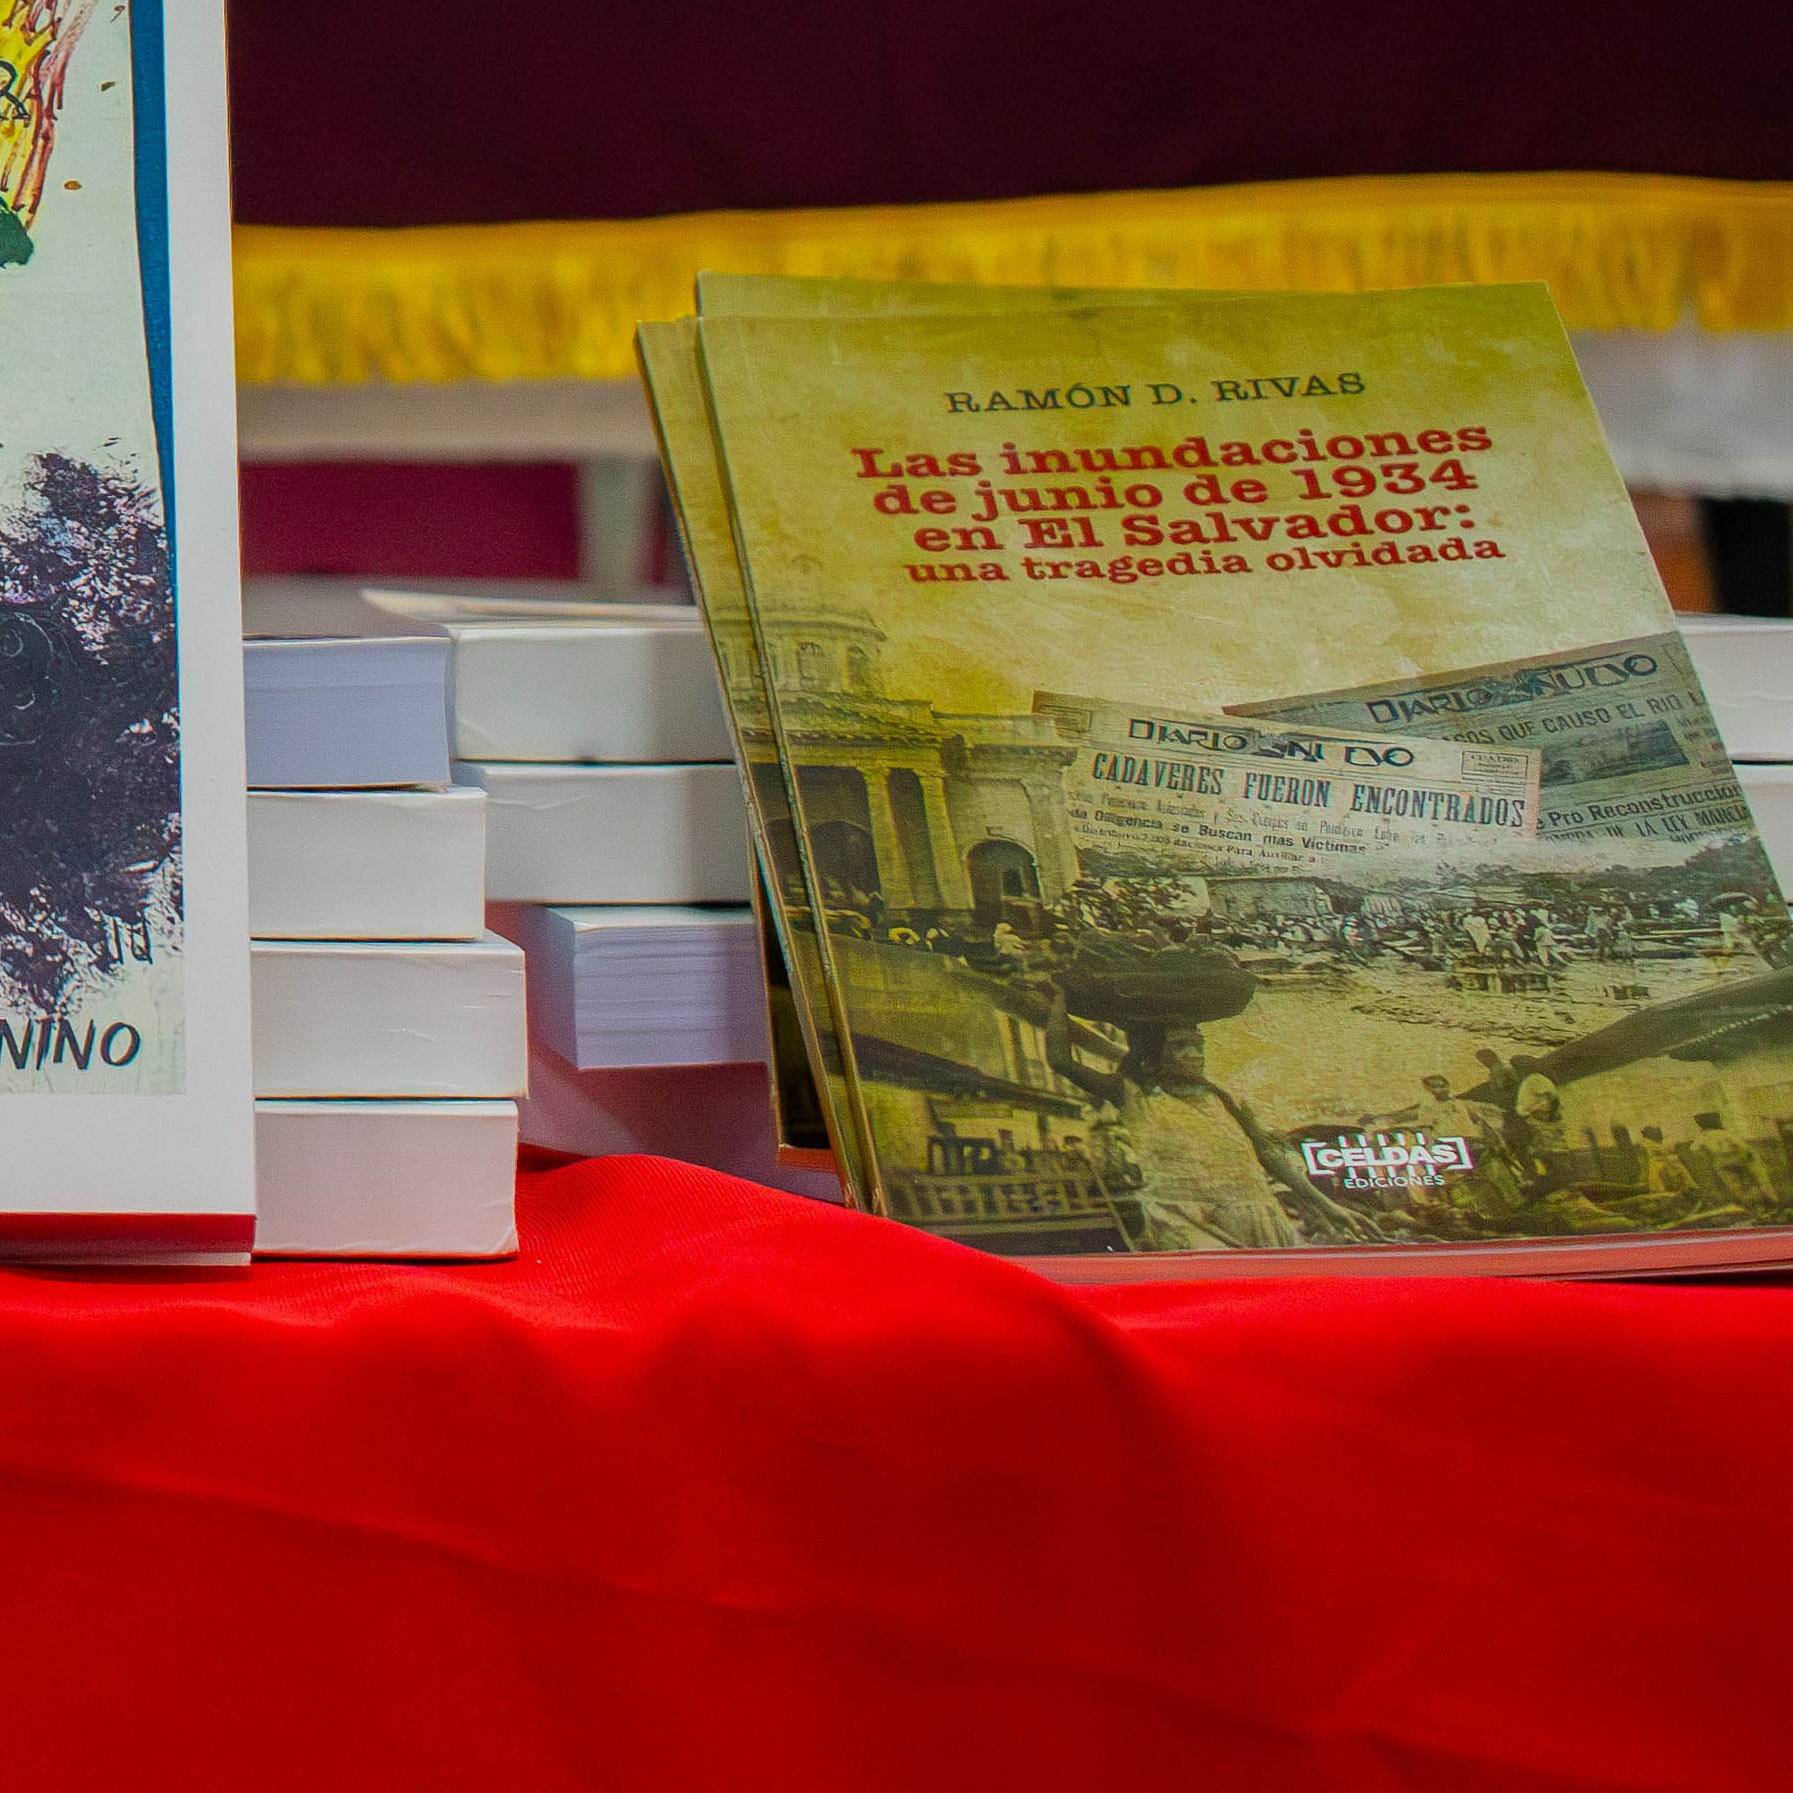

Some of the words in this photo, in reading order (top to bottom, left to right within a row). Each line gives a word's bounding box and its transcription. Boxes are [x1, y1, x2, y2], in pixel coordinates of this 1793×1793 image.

[946, 381, 1132, 413] RAMÓN
[1150, 382, 1197, 407] D.
[1213, 372, 1367, 403] RIVAS
[851, 443, 982, 480] Las
[998, 424, 1493, 476] inundaciones
[872, 483, 957, 517] de
[973, 471, 1163, 523] junio
[1183, 471, 1269, 507] de
[1290, 460, 1478, 501] 1934
[914, 521, 1004, 553] en
[1023, 513, 1103, 550] El
[1124, 499, 1475, 548] Salvador:
[904, 557, 1010, 584] una
[1020, 540, 1249, 585] tragedia
[1265, 535, 1507, 576] olvidada
[1364, 686, 1494, 724] DIARIO
[1498, 721, 1535, 744] QUE
[1542, 708, 1612, 736] CAUSO
[1619, 700, 1647, 720] EL
[1128, 718, 1248, 751] DIARIO
[1092, 752, 1225, 795] CADAVERES
[1243, 771, 1332, 808] FUERON
[1349, 783, 1526, 828] ENCONTRADOS
[1198, 824, 1253, 843] Buscan
[1549, 811, 1584, 829] Pro
[1316, 1143, 1458, 1169] CELDAS
[1343, 1174, 1446, 1190] EDICIONES
